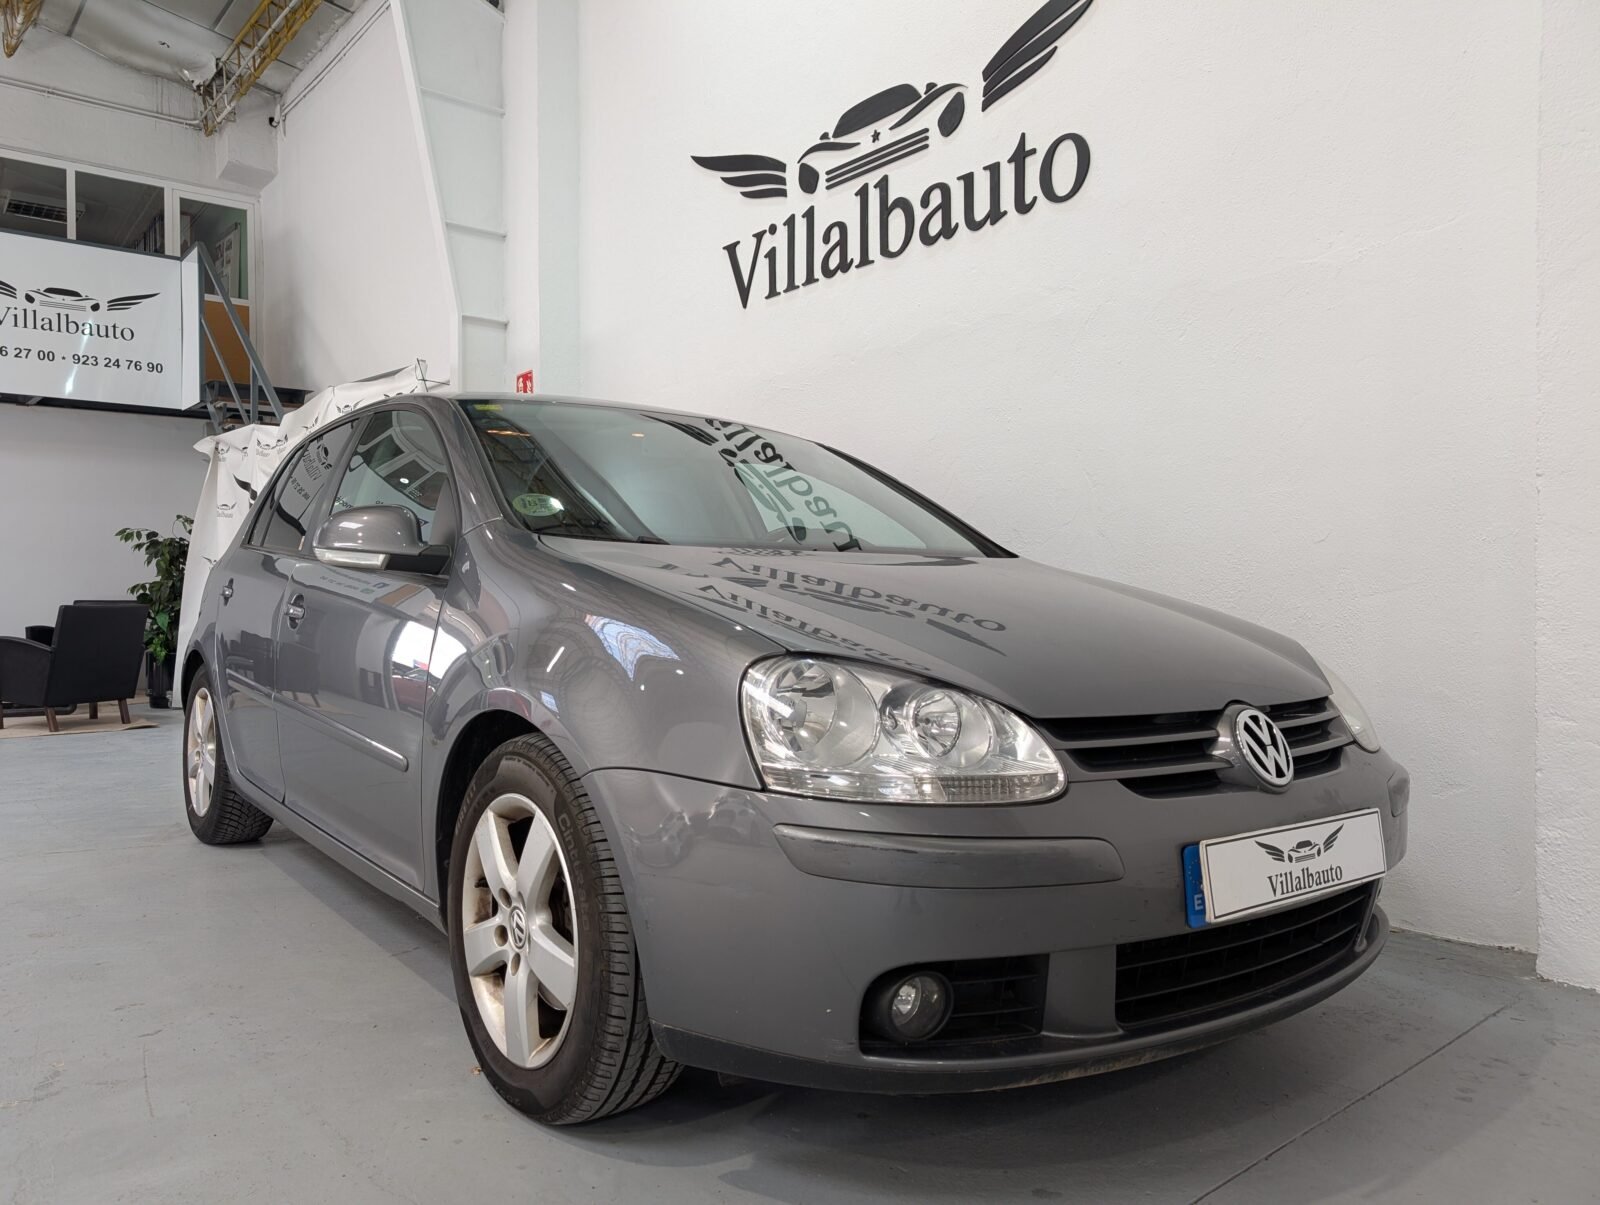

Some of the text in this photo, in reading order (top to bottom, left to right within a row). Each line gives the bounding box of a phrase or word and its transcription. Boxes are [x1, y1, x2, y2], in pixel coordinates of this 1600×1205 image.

[722, 131, 1092, 310] Villalbauto
[13, 347, 32, 360] 27
[37, 350, 56, 362] 00
[72, 353, 99, 367] 923
[103, 357, 121, 369] 24
[125, 360, 143, 372] 76
[146, 362, 164, 374] 90
[1267, 864, 1343, 897] Villalbauto
